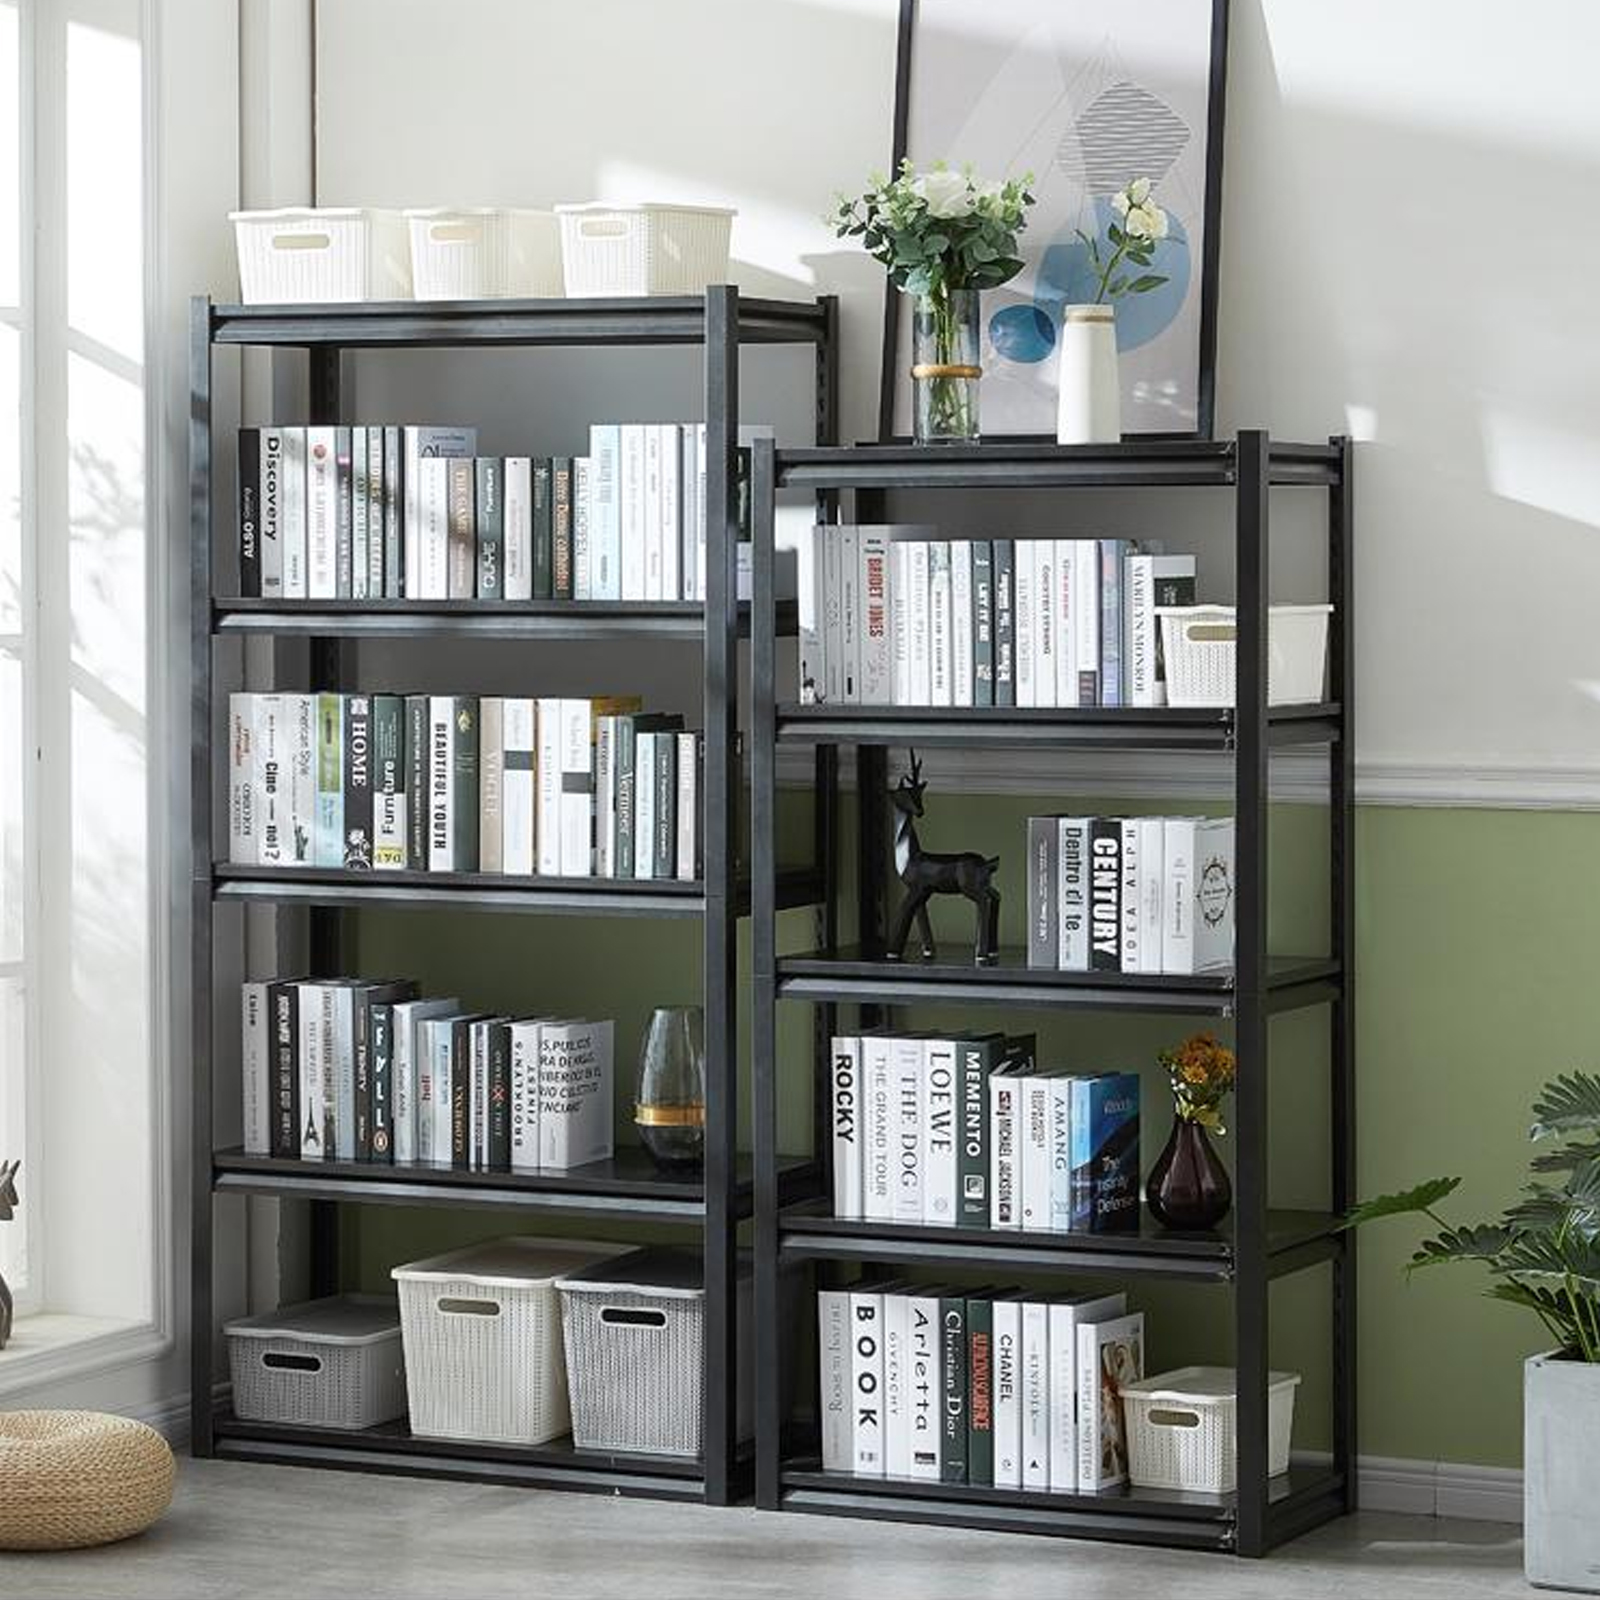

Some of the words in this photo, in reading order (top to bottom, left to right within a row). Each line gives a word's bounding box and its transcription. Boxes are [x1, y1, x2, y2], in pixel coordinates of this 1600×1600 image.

[265, 437, 280, 541] Discovery
[867, 605, 883, 638] JONES
[978, 582, 989, 606] LET
[978, 609, 989, 623] IT
[1133, 565, 1145, 630] MARILYN
[978, 624, 989, 643] BE
[298, 700, 310, 748] American
[298, 750, 311, 776] Style
[352, 721, 367, 787] HOME
[434, 722, 447, 798] BEAUTIFUL
[434, 803, 447, 850] YOUTH
[618, 771, 633, 836] Vermeer
[1065, 827, 1083, 884] Dentro
[1065, 889, 1083, 906] di
[1067, 914, 1083, 931] te
[1092, 837, 1119, 956] CENTURY
[527, 1064, 536, 1126] FINEST
[836, 1053, 854, 1143] ROCKY
[875, 1057, 887, 1087] THE
[900, 1071, 918, 1125] THE
[875, 1090, 887, 1149] GRAND
[929, 1051, 952, 1154] LOEWE
[965, 1051, 981, 1157] MEMENTO
[900, 1133, 918, 1187] DOG
[998, 1118, 1012, 1157] MICHAEL
[1053, 1096, 1067, 1170] AMANG
[875, 1153, 887, 1197] TOUR
[998, 1159, 1012, 1202] JACKSON
[856, 1305, 877, 1427] BOOK
[889, 1331, 899, 1416] GIVENCHY
[914, 1308, 931, 1431] Arletta
[945, 1310, 962, 1389] Christian
[1000, 1334, 1013, 1403] CHANEL
[1030, 1353, 1040, 1418] KINFOLK
[945, 1393, 962, 1440] Dior
